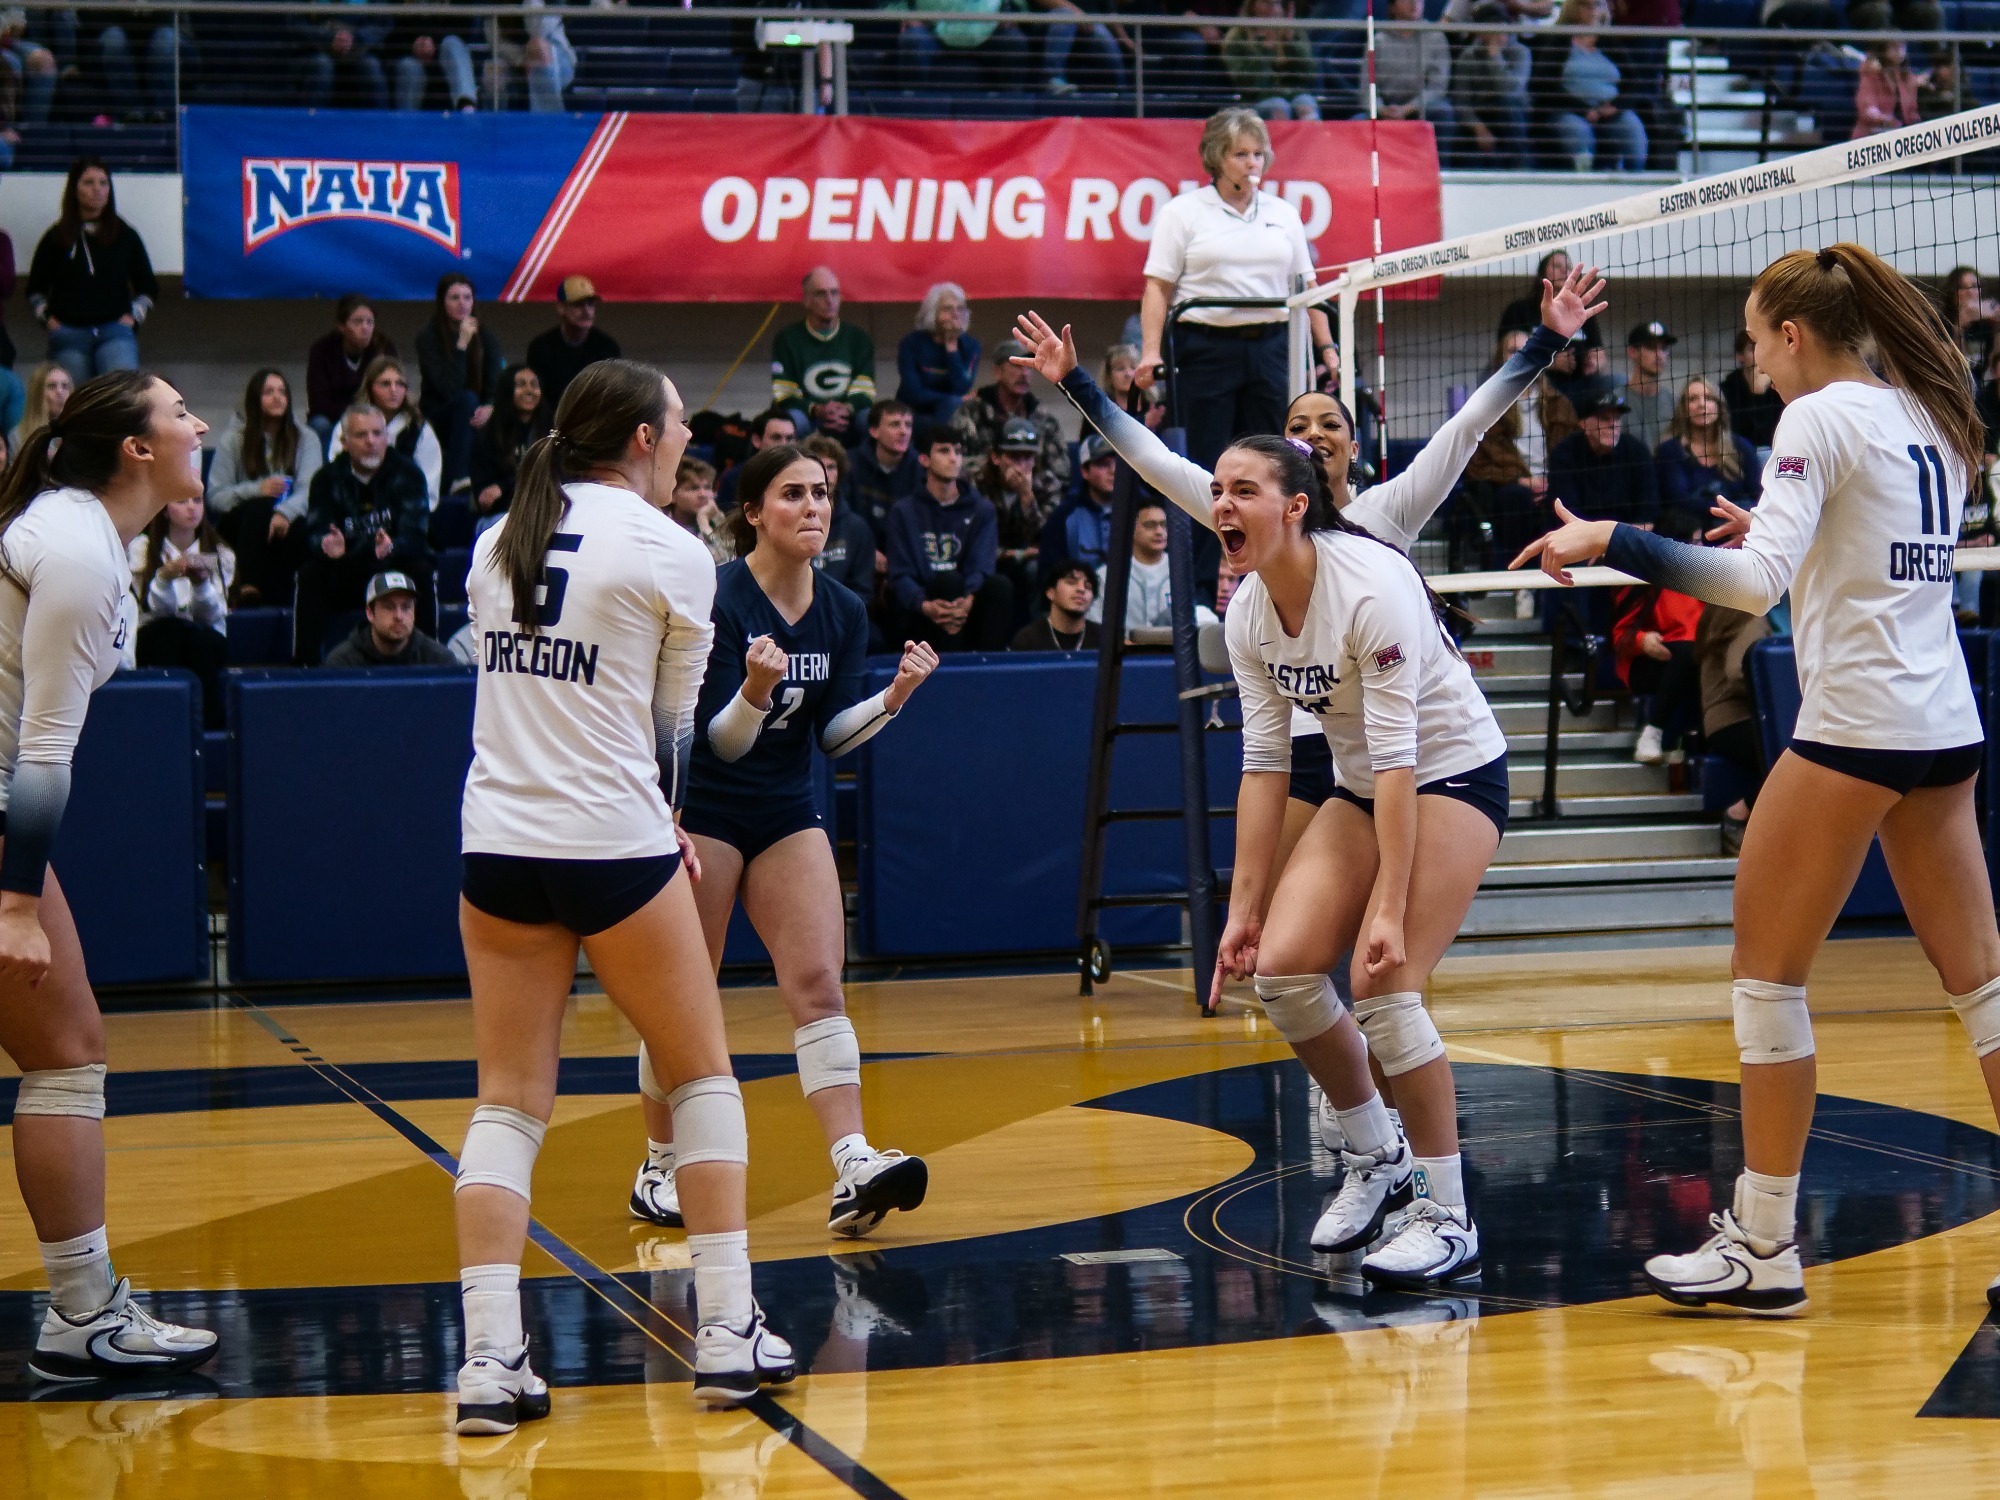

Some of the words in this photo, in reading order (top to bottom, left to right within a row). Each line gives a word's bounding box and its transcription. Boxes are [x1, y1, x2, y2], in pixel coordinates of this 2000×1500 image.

[1847, 141, 1891, 169] EASTERN
[1895, 129, 1942, 158] OREGON
[246, 159, 457, 246] NAIA
[701, 176, 1047, 242] OPENING
[1065, 177, 1332, 241] ROD
[1660, 189, 1697, 214] EASTERN
[1699, 180, 1738, 205] OREGON
[1740, 166, 1796, 195] VOLLEYBALL
[1505, 231, 1537, 250] EASTERN
[1538, 222, 1571, 242] OREGON
[1572, 209, 1619, 234] VOLLEYBALL
[1401, 254, 1429, 273] OREGON
[1430, 245, 1470, 266] VOLLEYBALL
[804, 362, 852, 398] G
[1907, 444, 1951, 536] 11
[484, 630, 599, 686] OREGON
[767, 687, 805, 730] 2
